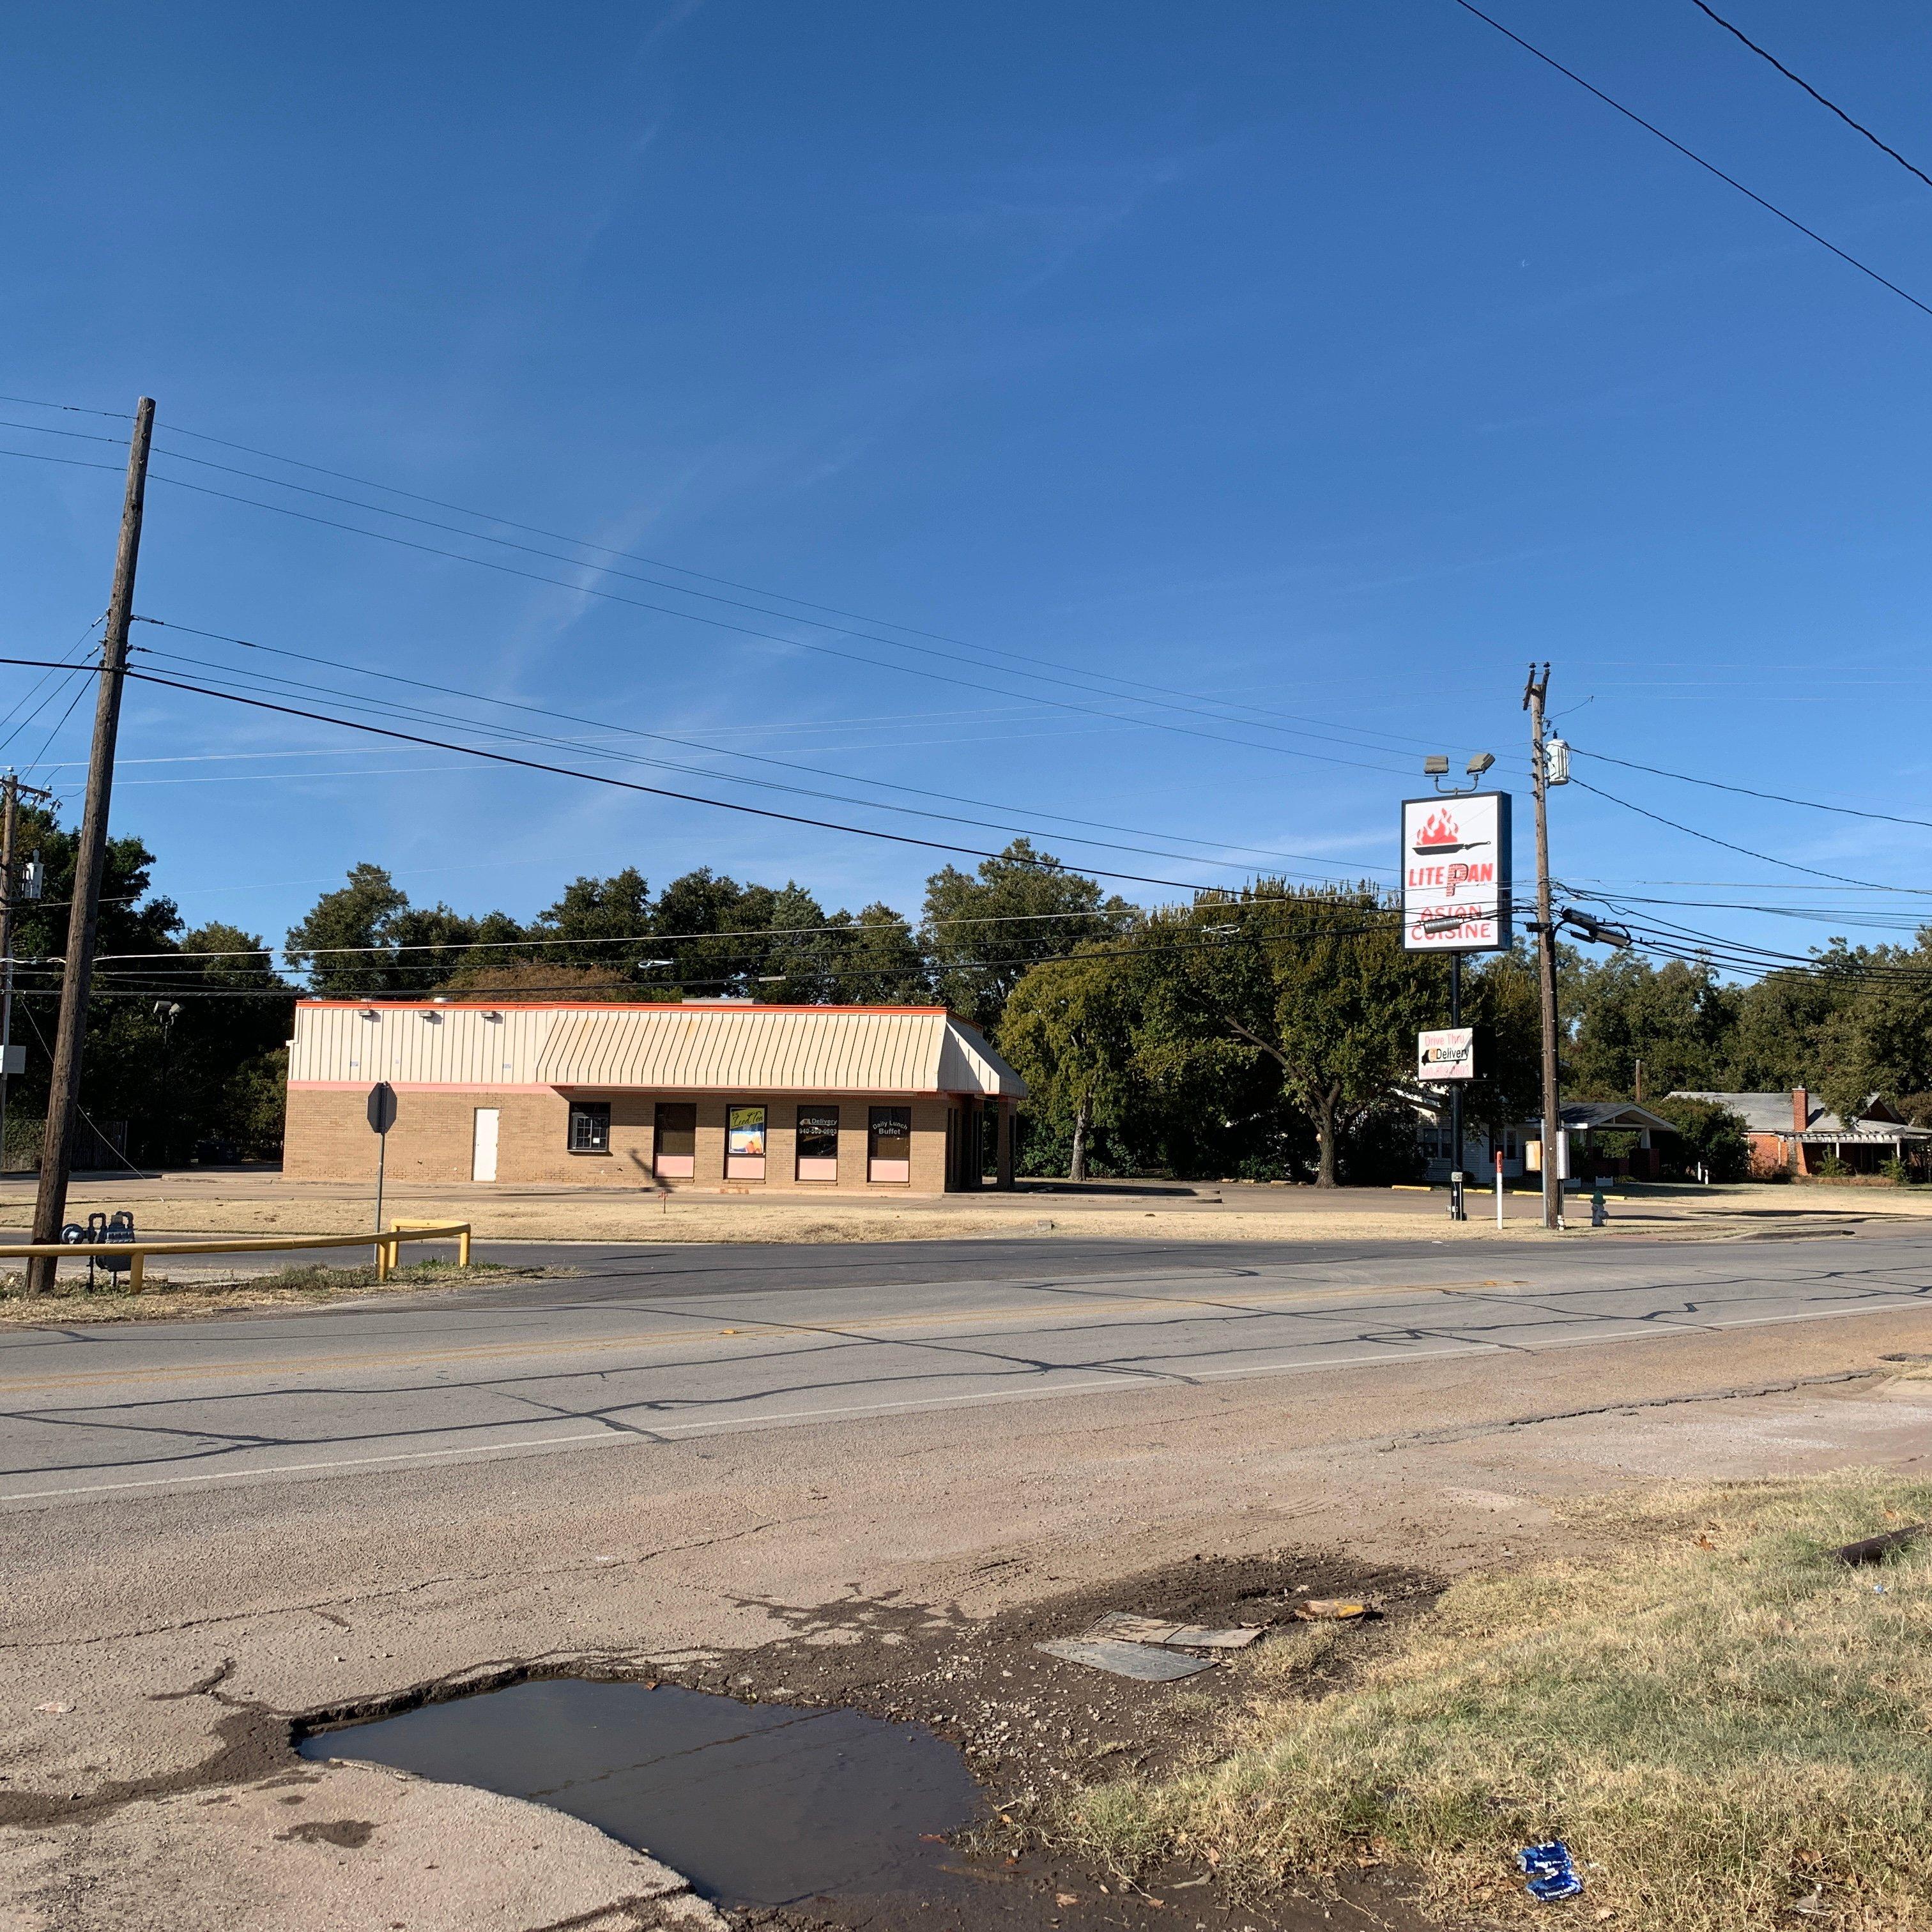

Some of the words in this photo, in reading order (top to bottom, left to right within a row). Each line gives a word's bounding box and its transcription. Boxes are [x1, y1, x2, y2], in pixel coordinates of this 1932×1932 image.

[1409, 867, 1445, 886] LITE
[1446, 863, 1493, 897] PAN
[1421, 905, 1482, 922] ASIAN
[1425, 1035, 1445, 1046] Drive
[1447, 1033, 1465, 1045] Thru
[1436, 1048, 1469, 1060] Delivery
[872, 1121, 888, 1130] Daily
[889, 1120, 908, 1130] Lunch
